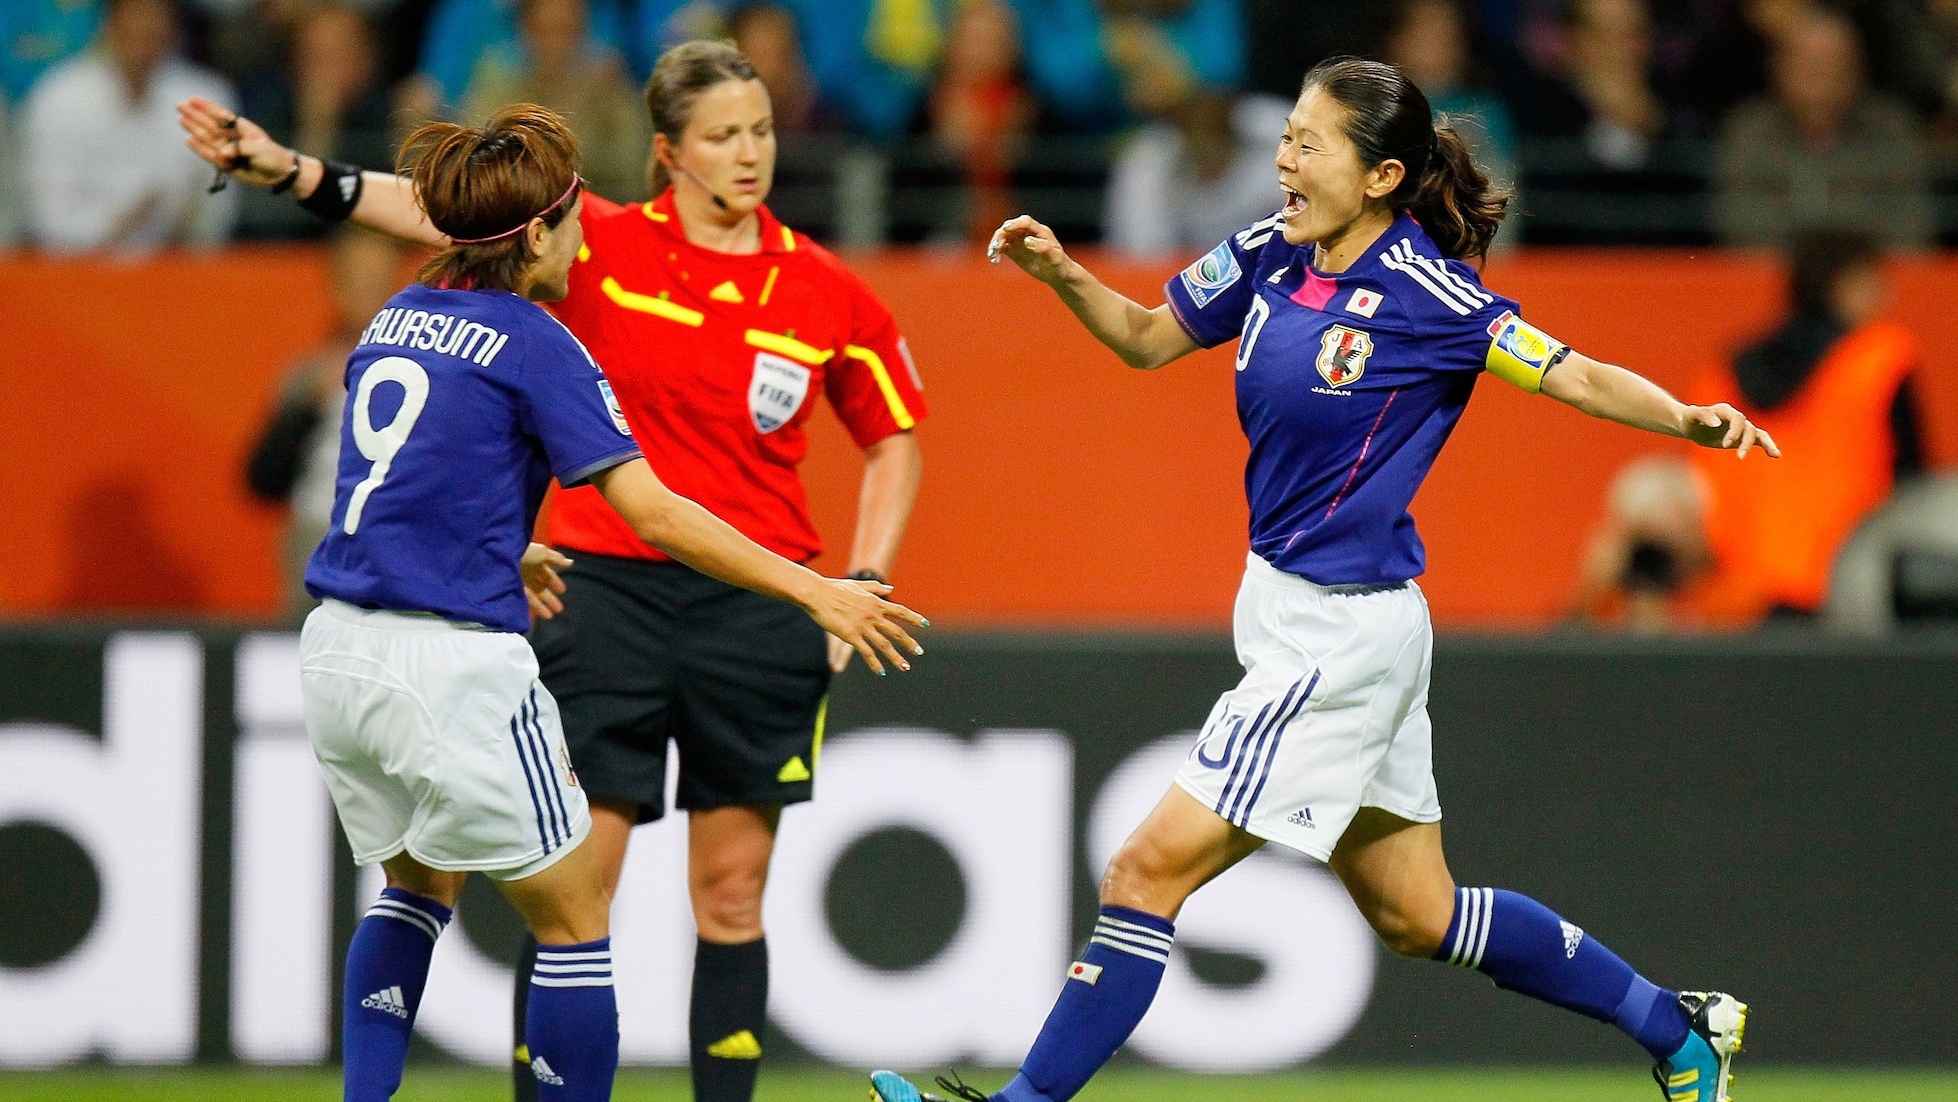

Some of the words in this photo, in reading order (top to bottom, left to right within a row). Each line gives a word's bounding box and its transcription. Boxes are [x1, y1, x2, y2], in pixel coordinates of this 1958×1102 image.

[1311, 386, 1352, 396] JAPAN
[344, 356, 430, 536] 9
[361, 998, 409, 1019] adidas
